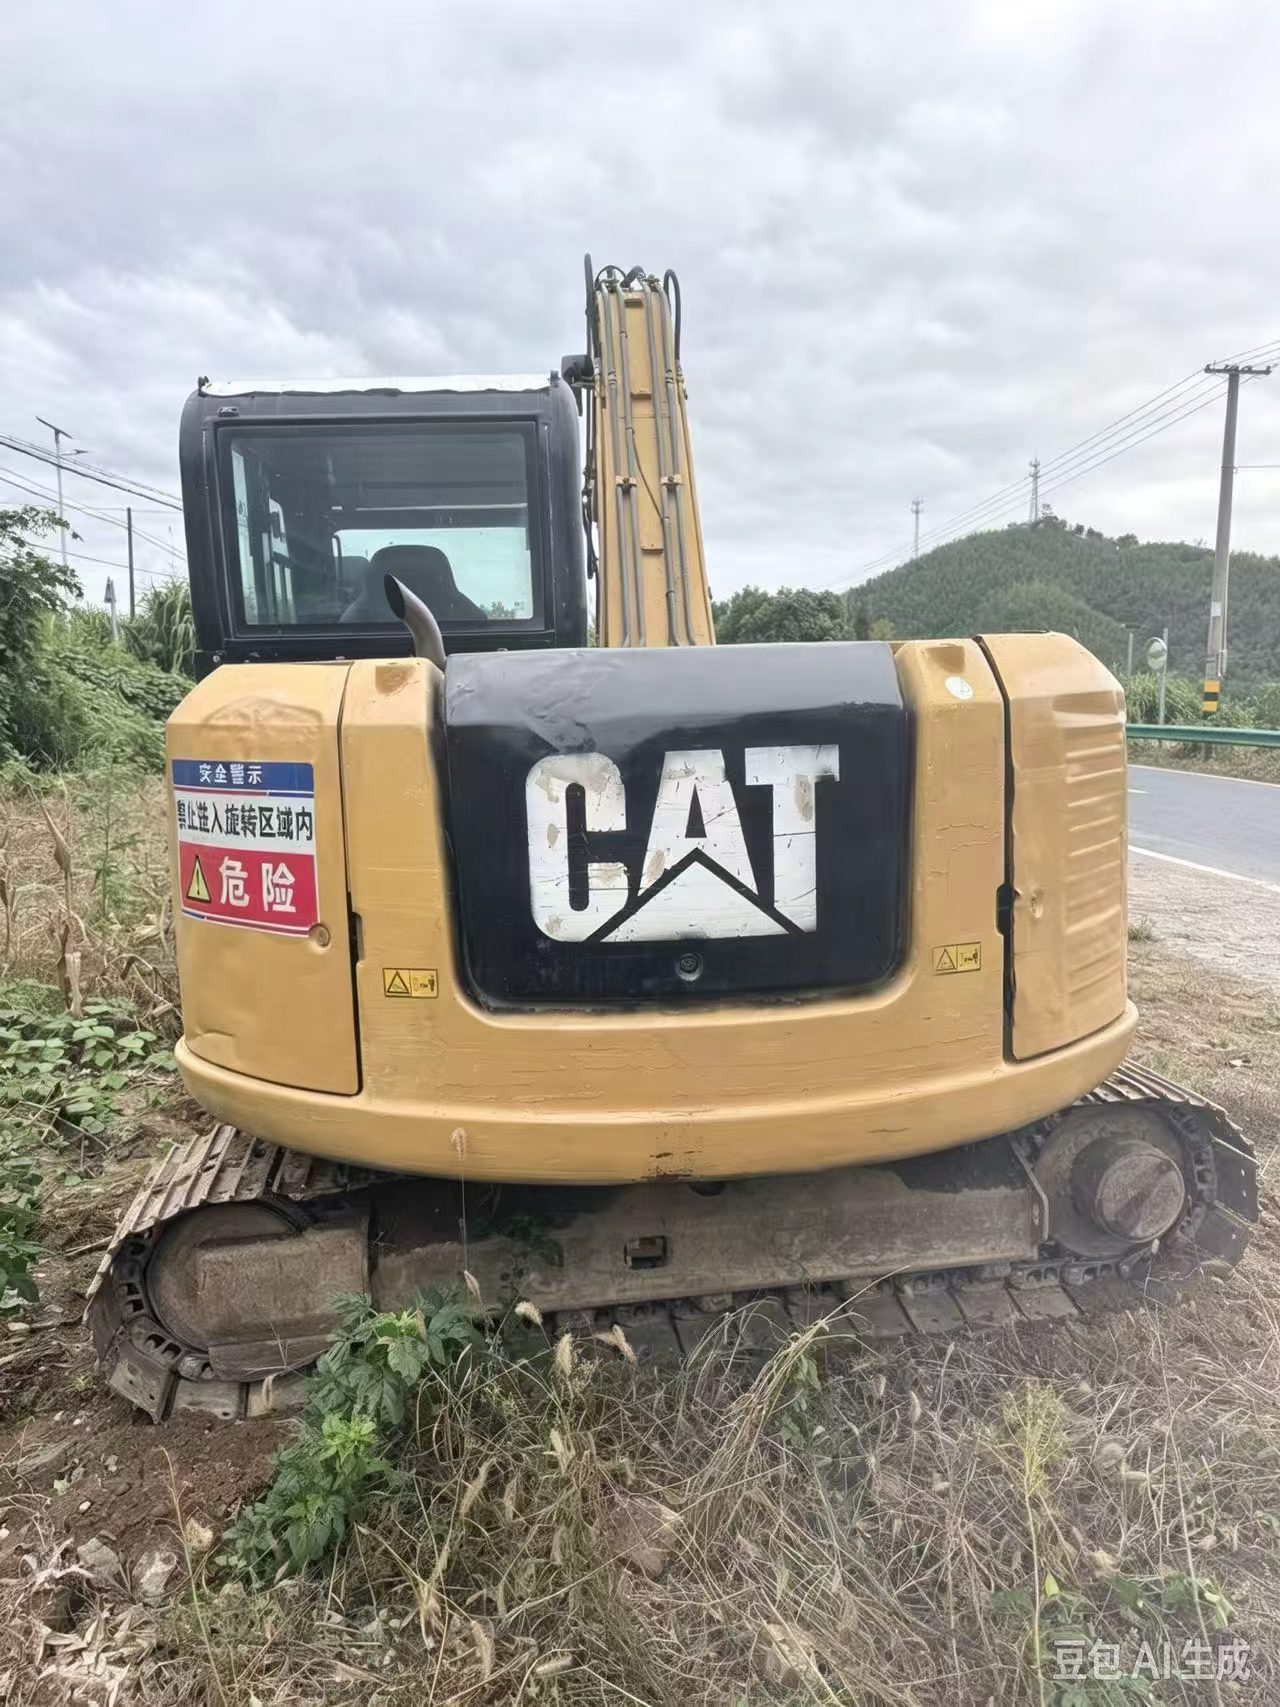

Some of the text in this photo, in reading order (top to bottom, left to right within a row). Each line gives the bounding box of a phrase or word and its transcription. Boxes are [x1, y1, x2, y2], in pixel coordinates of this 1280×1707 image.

[199, 763, 263, 785] 安全警示
[525, 744, 840, 942] CAT
[218, 856, 297, 913] 危险
